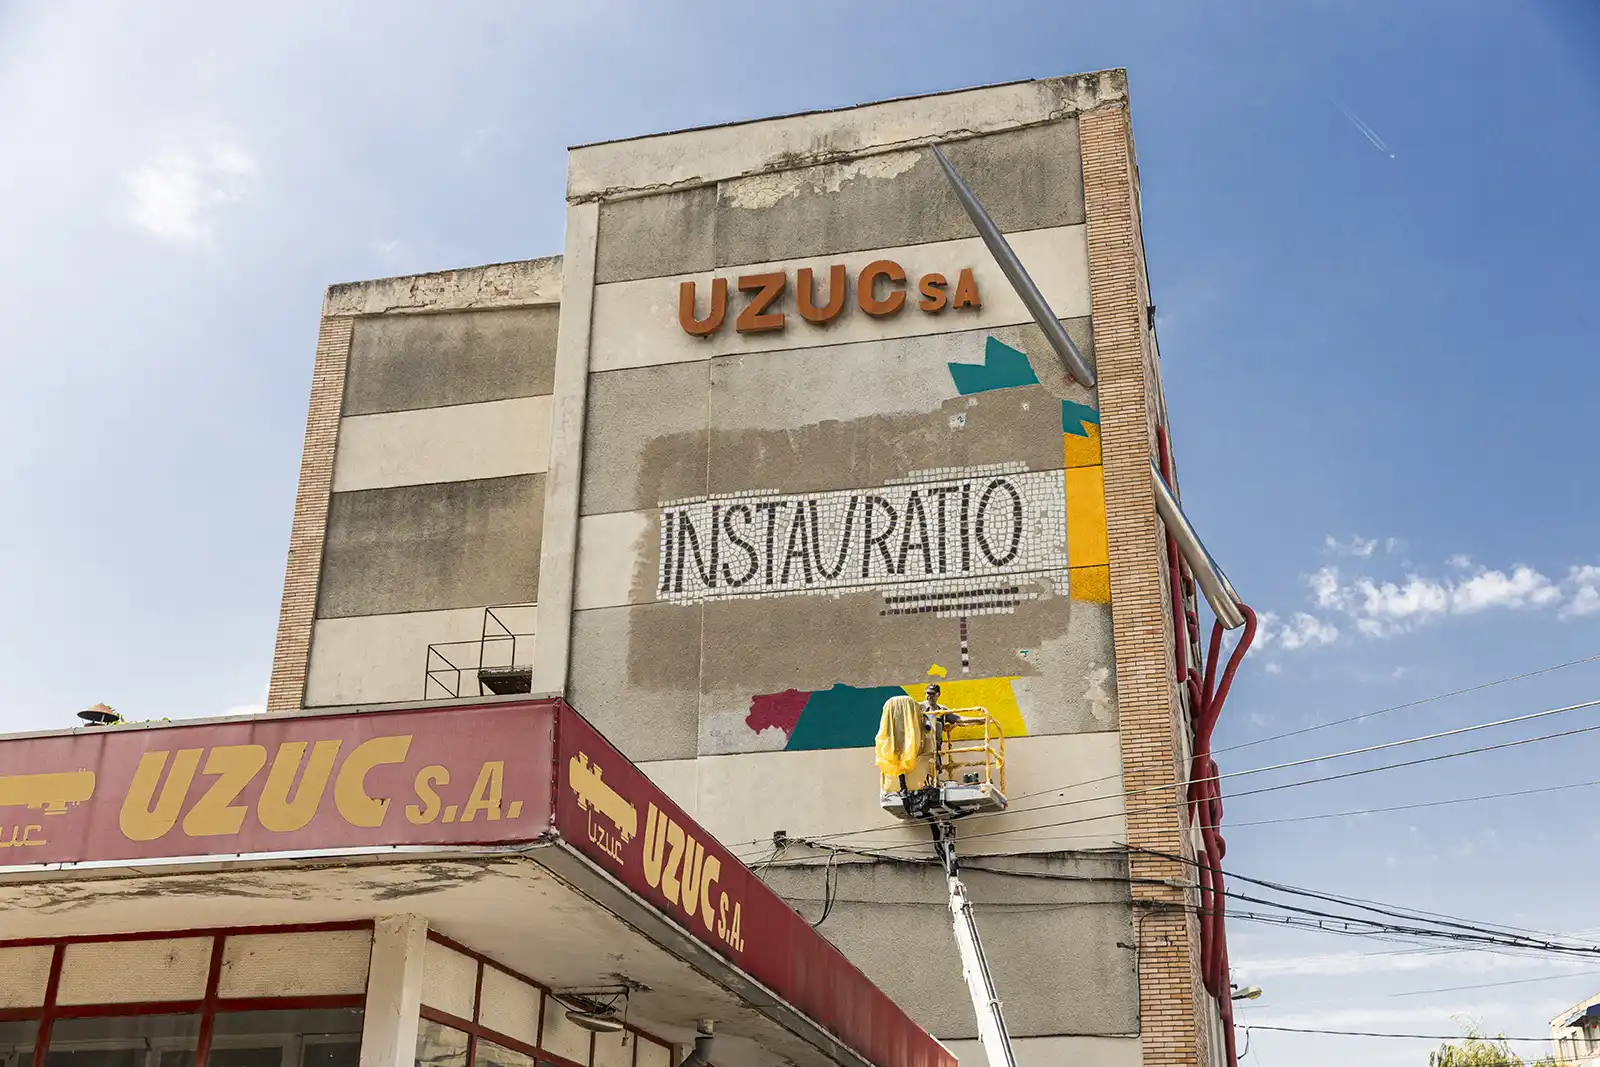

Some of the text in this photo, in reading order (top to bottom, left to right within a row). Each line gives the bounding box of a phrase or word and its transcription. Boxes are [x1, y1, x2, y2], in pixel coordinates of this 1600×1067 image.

[678, 259, 981, 338] UZUC SA
[660, 477, 1023, 593] INSTAURATIO
[119, 735, 523, 841] UZUC S.A.
[643, 801, 744, 953] UZUC S.A.
